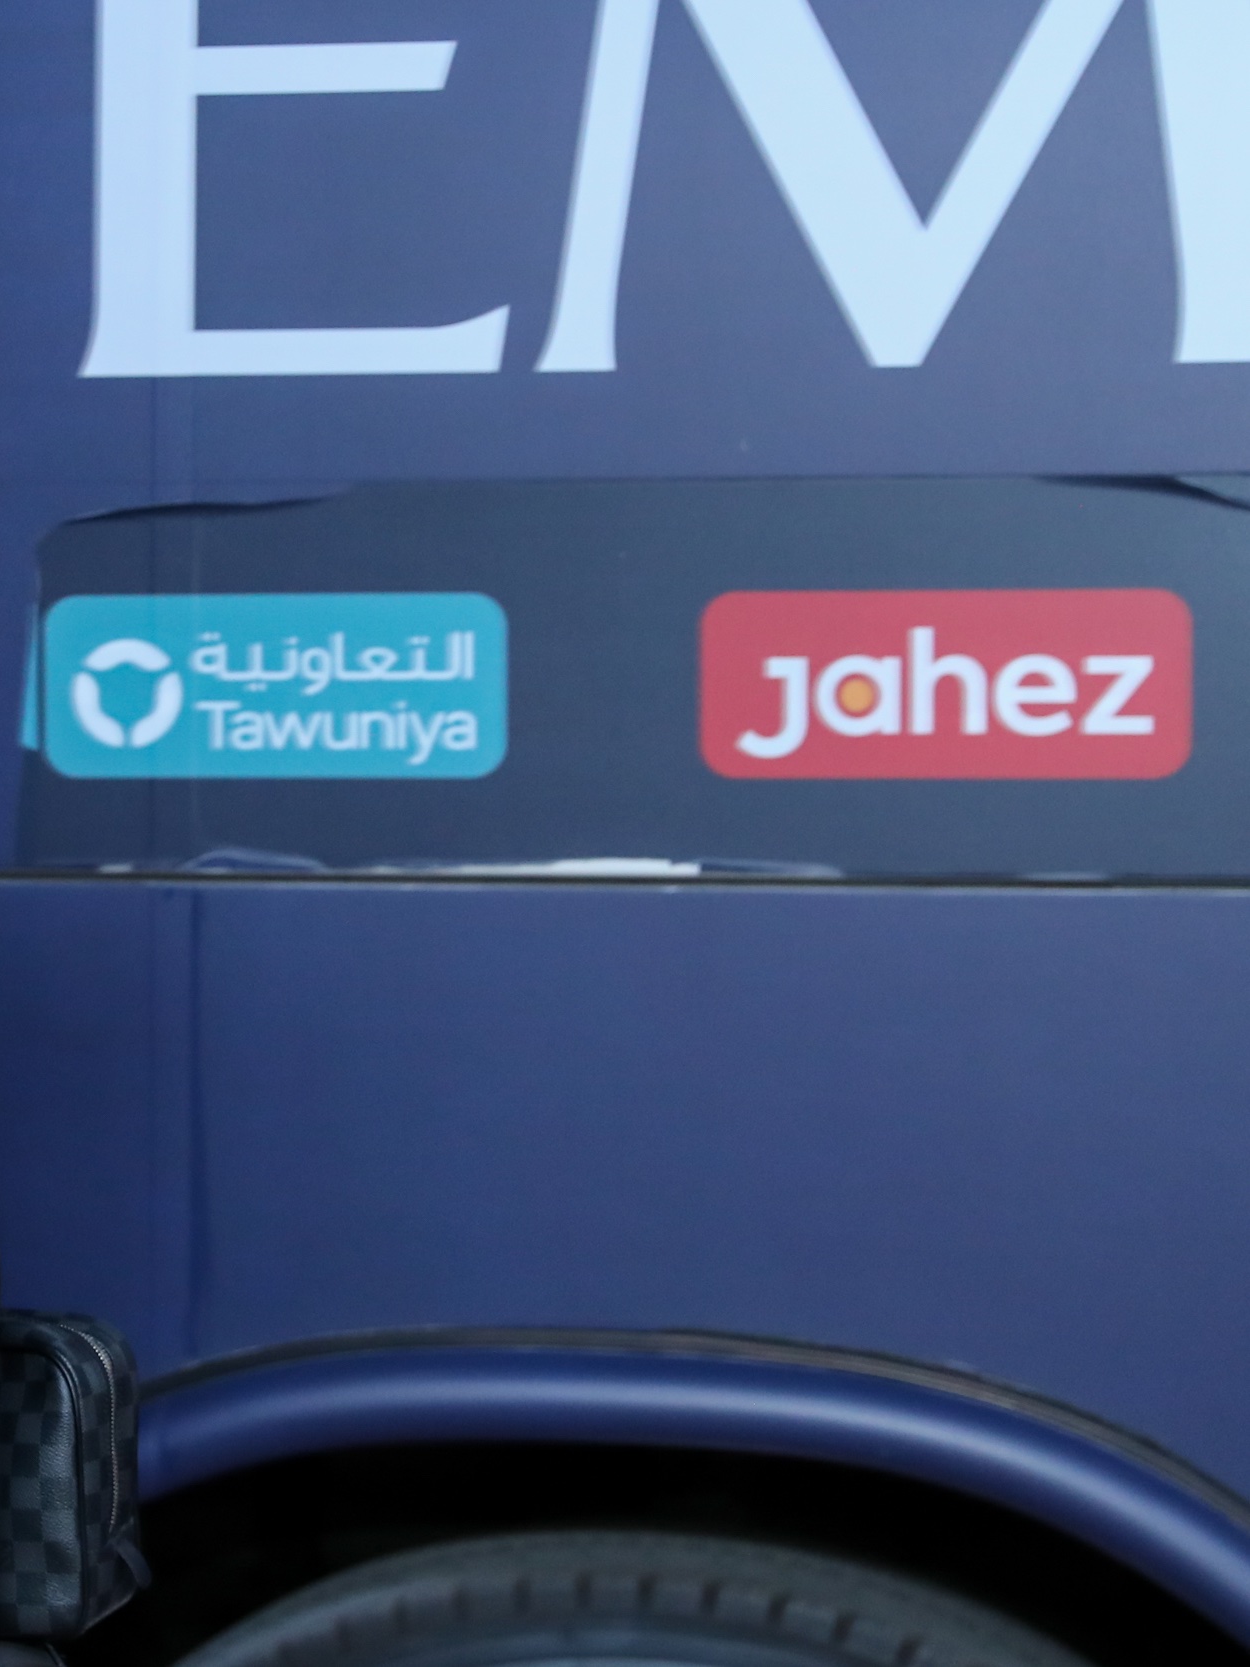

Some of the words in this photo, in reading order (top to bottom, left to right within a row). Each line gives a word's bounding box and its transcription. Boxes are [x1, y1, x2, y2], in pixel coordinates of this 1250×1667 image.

[190, 631, 475, 696] التعاونية
[735, 625, 1155, 759] jahez
[194, 700, 479, 766] Tawuniya
